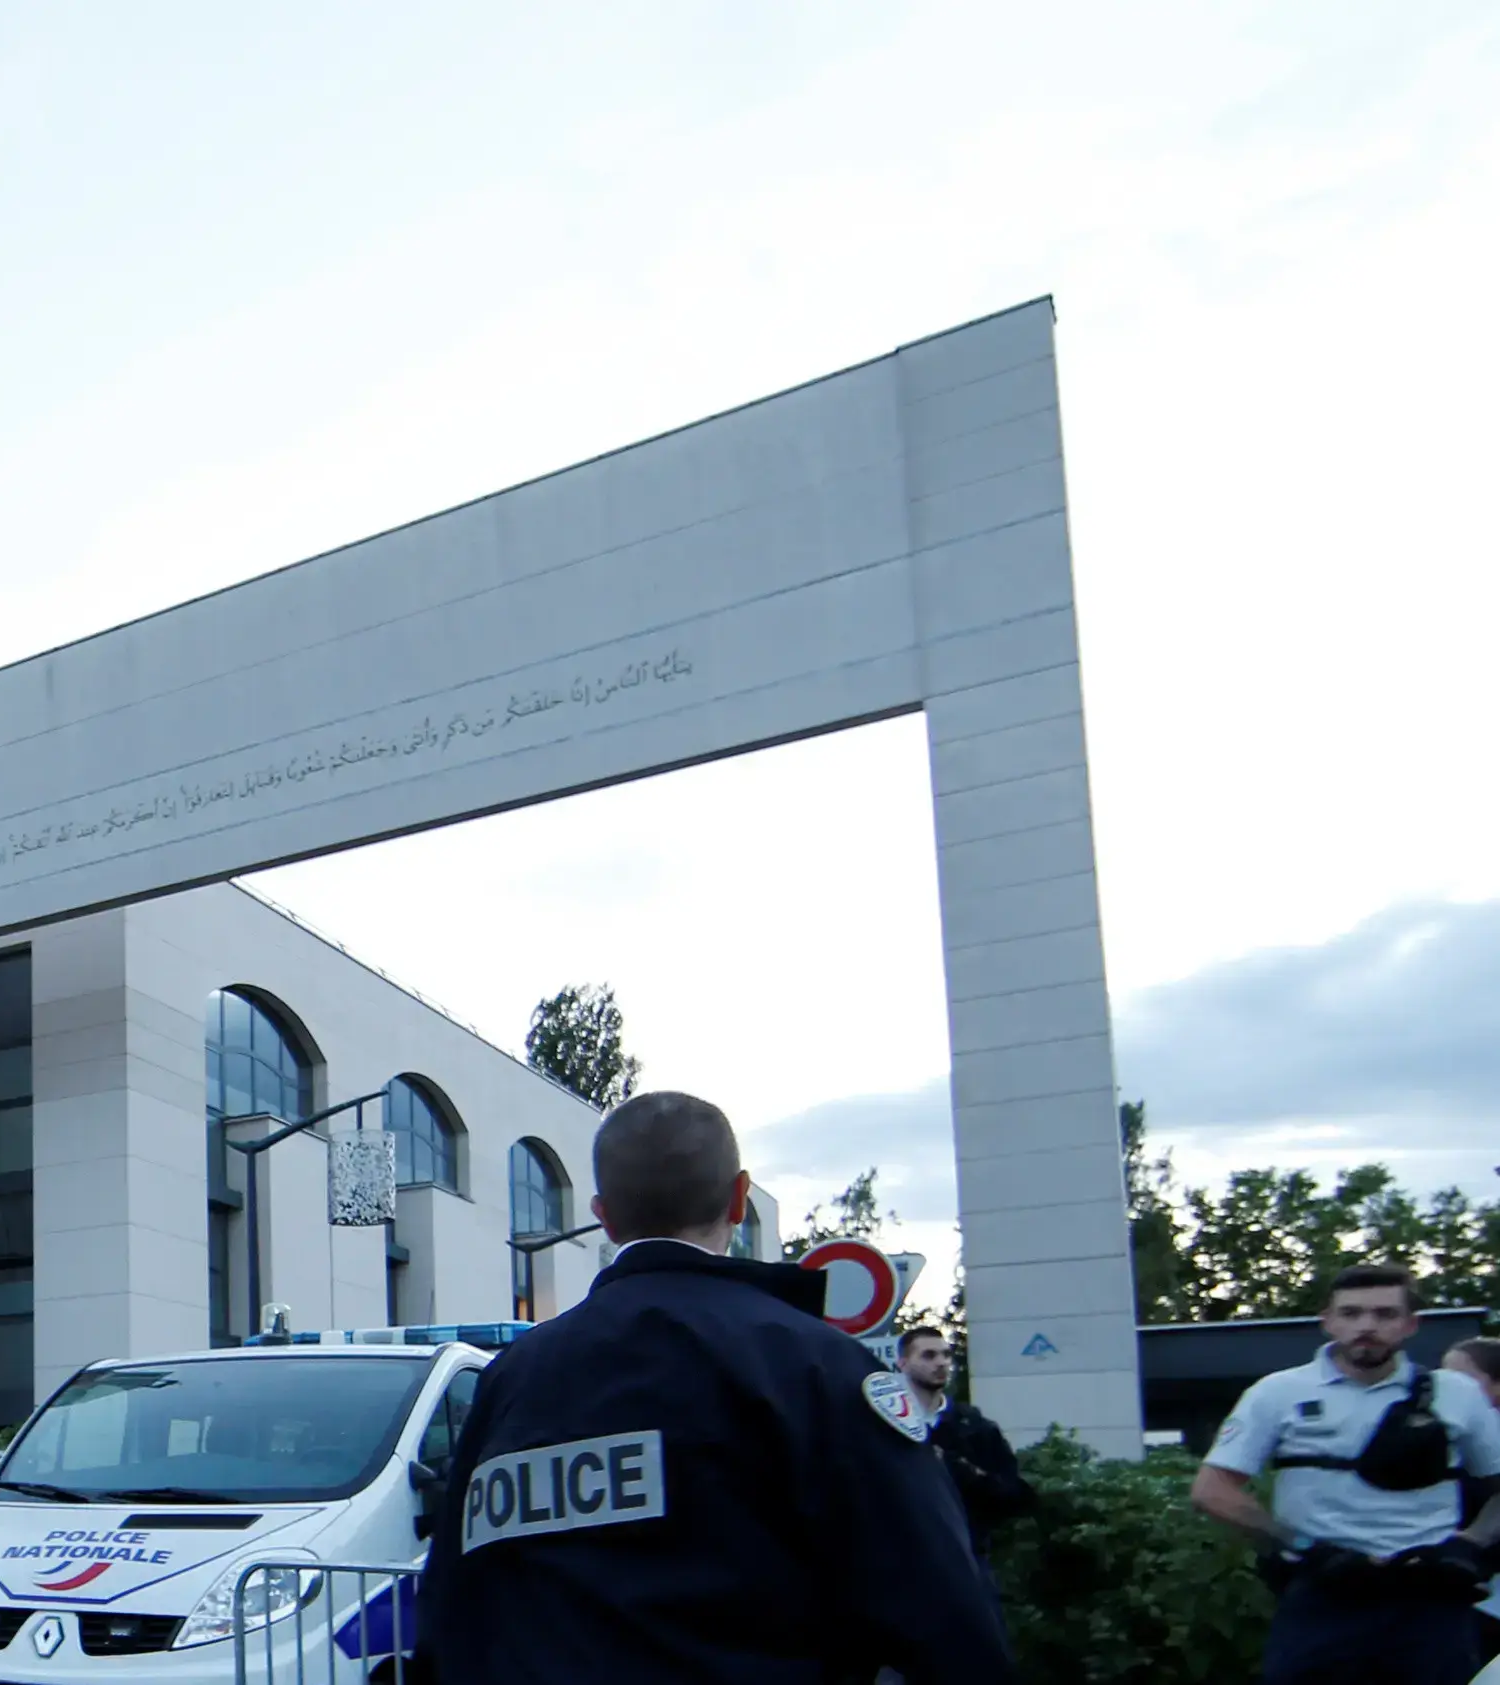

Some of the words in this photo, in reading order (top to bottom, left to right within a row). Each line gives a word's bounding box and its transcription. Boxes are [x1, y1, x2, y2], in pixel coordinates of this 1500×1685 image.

[467, 1443, 647, 1540] POLICE
[43, 1530, 150, 1545] POLICE
[0, 1545, 173, 1565] NATIONALE
